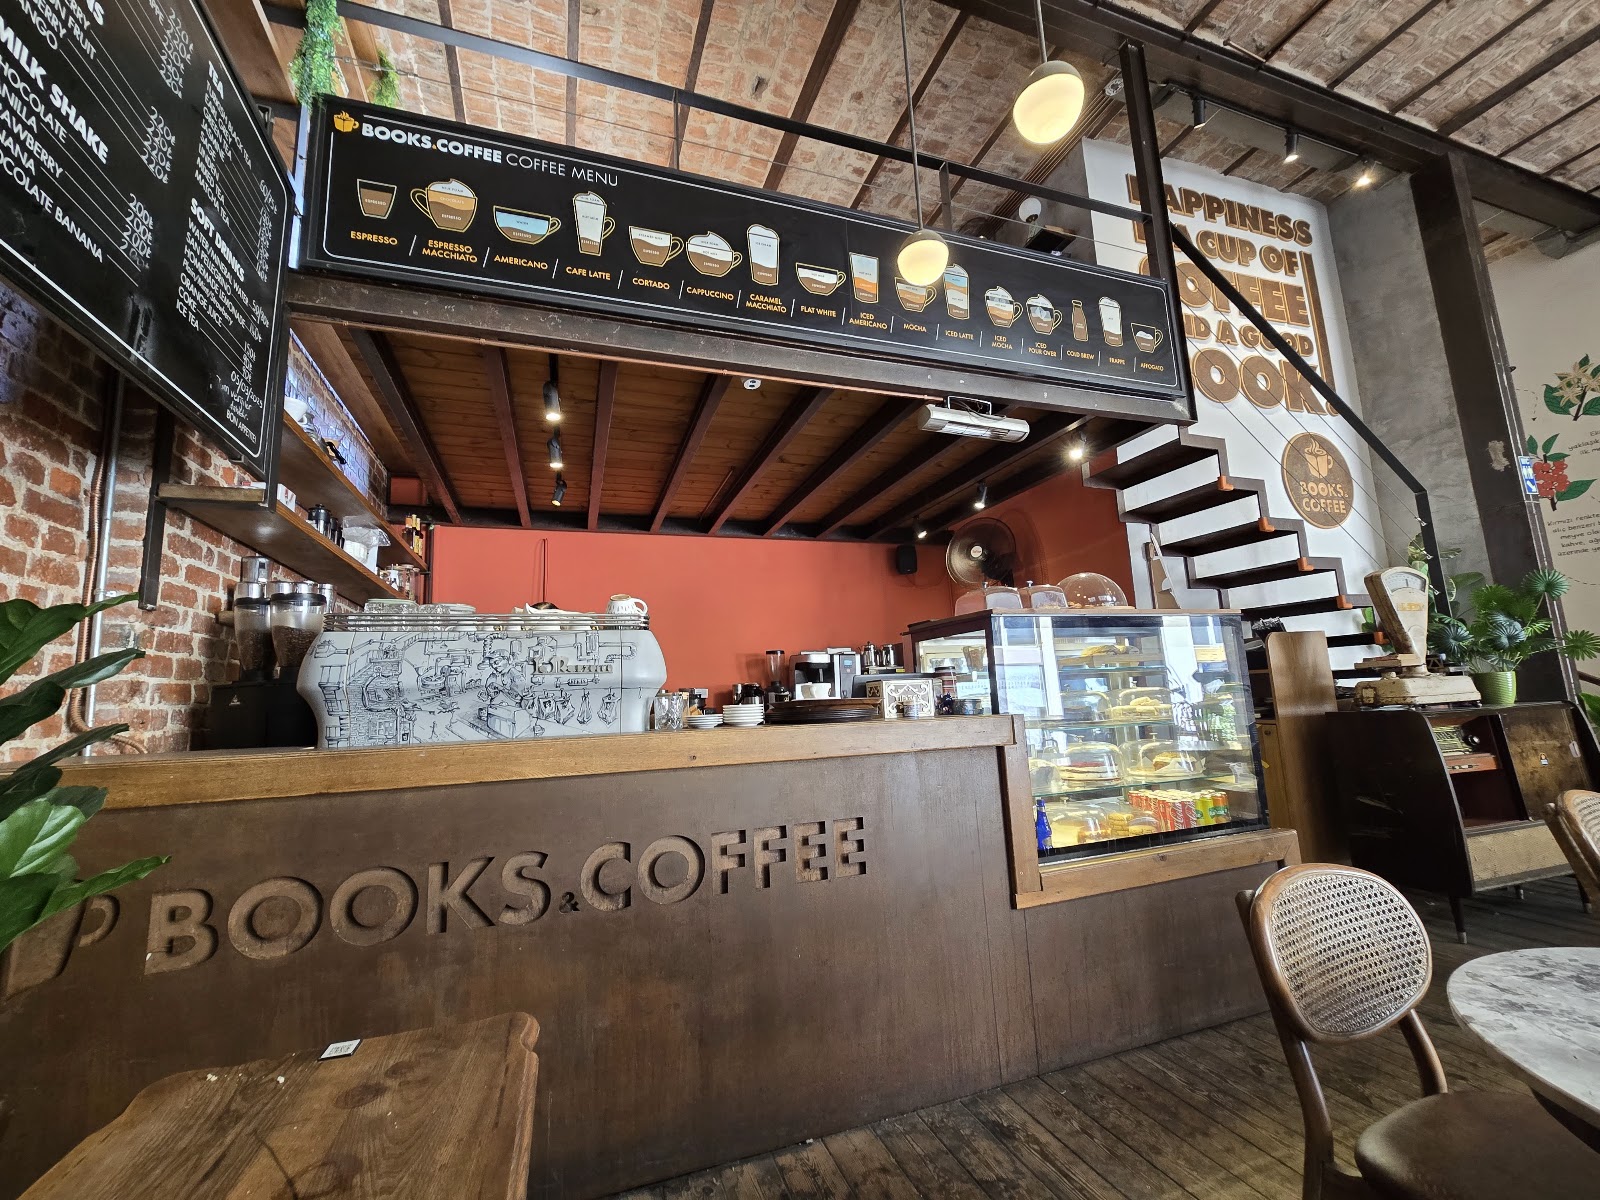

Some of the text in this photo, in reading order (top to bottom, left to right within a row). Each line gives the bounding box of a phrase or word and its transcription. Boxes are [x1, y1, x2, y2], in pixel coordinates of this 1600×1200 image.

[68, 15, 96, 60] FRUIT
[208, 60, 224, 100] TEA
[49, 83, 109, 165] SHAKE
[506, 152, 566, 177] COFFEE
[571, 166, 619, 188] MENU
[55, 206, 102, 263] BANANA
[190, 198, 244, 282] SOFT DRINKS
[350, 230, 398, 246] ESPRESSO
[186, 232, 200, 256] SAN
[428, 239, 473, 254] ESPRESSO
[422, 247, 478, 264] MACCHIATO
[1196, 230, 1257, 267] CUP
[1259, 244, 1300, 277] OF
[494, 254, 549, 271] AMERICANO
[565, 266, 611, 281] CAFE LATTE
[632, 277, 670, 290] CORTADO
[179, 286, 197, 313] COKE
[180, 273, 222, 327] ORANGE JUICE
[686, 286, 734, 301] CAPPUCCINO
[750, 293, 783, 305] CARAMEL
[176, 299, 200, 331] ICE TEA
[746, 301, 787, 314] MACCHIATO
[800, 305, 837, 318] FLAT WHITE
[860, 312, 875, 320] ICED
[849, 317, 888, 330] AMERICANO
[903, 323, 927, 333] MOCHA
[945, 330, 974, 341] ICED LATTE
[1216, 320, 1239, 346] A
[992, 341, 1013, 350] MOCHA
[226, 408, 238, 428] BON
[1302, 498, 1347, 514] COFFEE
